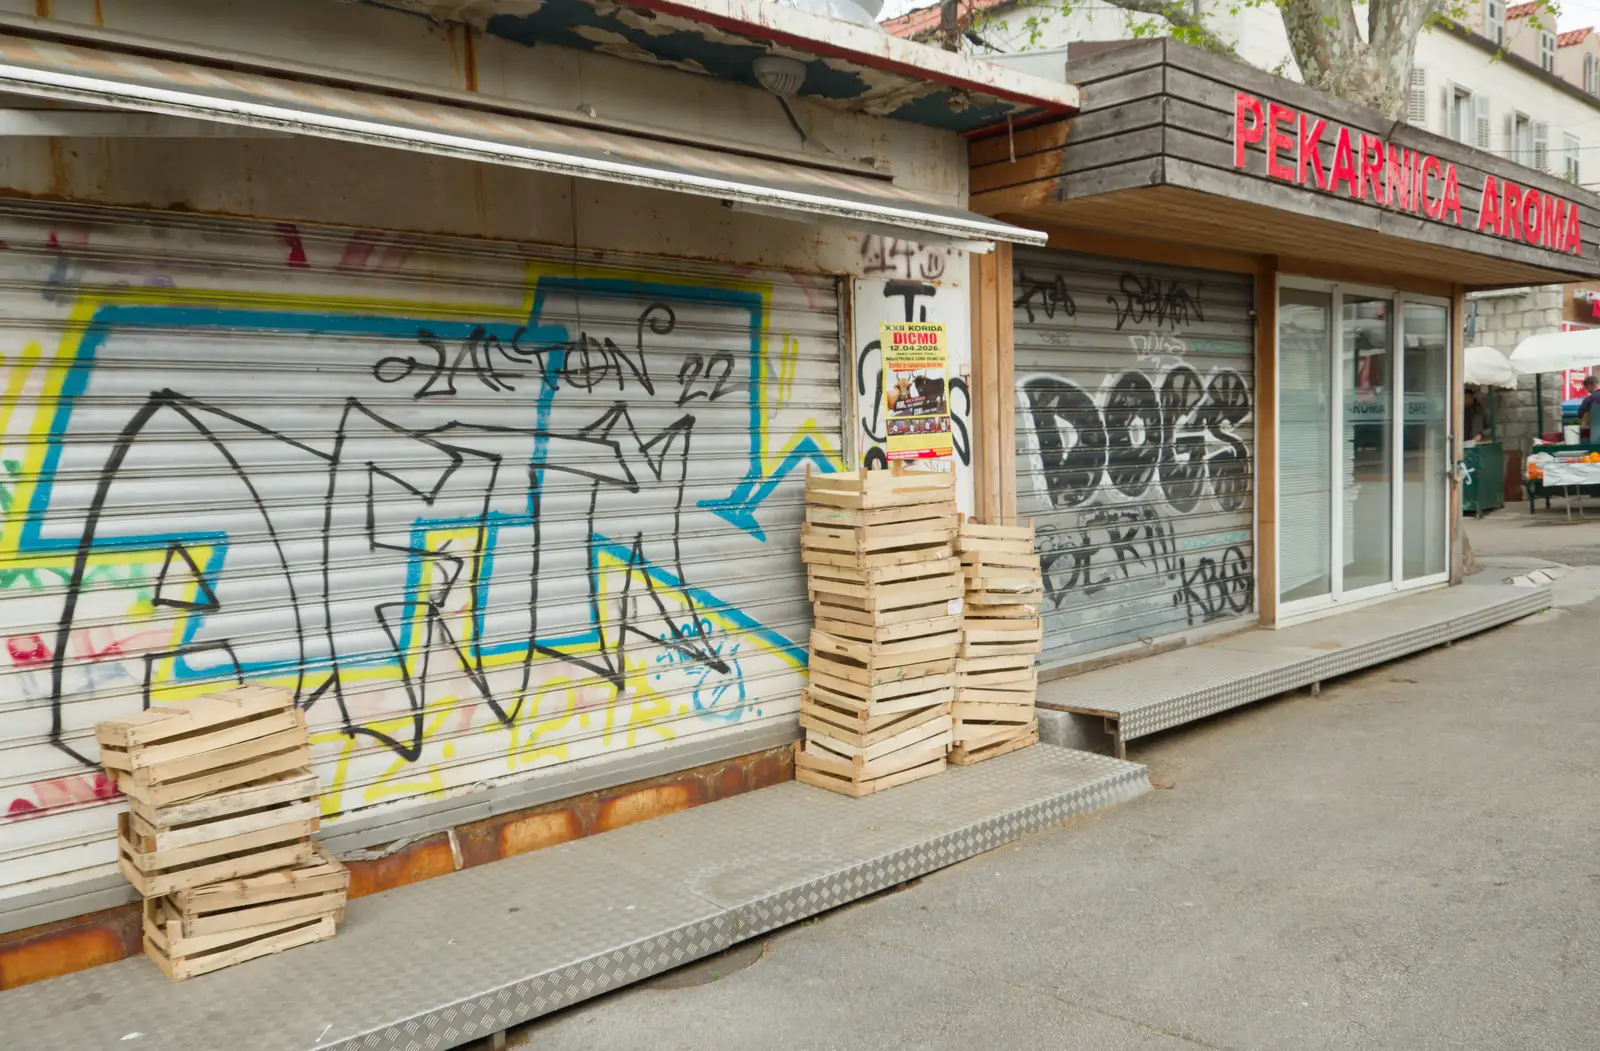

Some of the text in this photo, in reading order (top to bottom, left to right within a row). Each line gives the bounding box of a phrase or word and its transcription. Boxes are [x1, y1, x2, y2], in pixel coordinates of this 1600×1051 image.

[1233, 91, 1581, 256] PEKARNICA AROMA
[893, 332, 938, 345] DICMO
